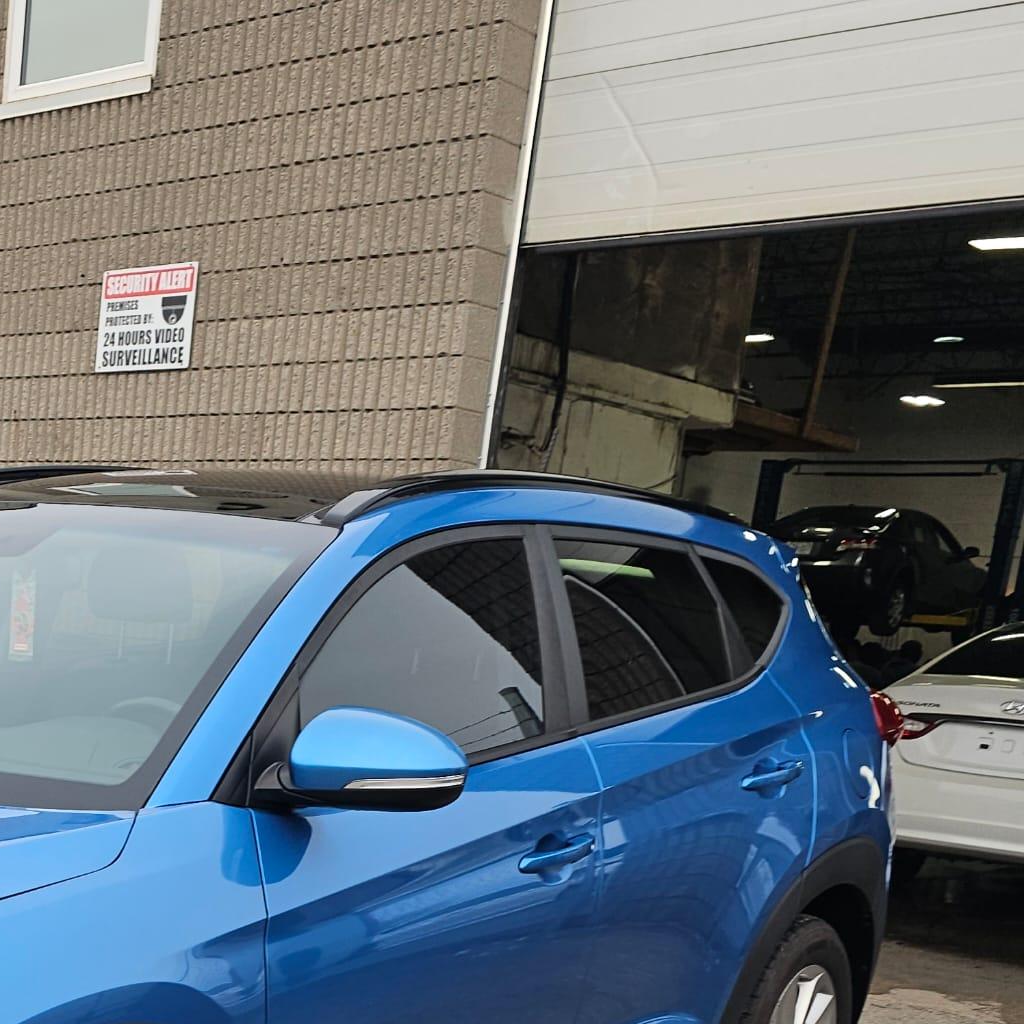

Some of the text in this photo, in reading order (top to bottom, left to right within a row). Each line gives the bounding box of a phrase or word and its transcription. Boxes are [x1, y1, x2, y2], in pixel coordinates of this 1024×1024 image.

[106, 300, 138, 312] PREMISES
[105, 314, 142, 327] PROTECTED
[103, 327, 185, 347] 24 HOURS VIDEO
[102, 346, 184, 367] SURVEILLANCE
